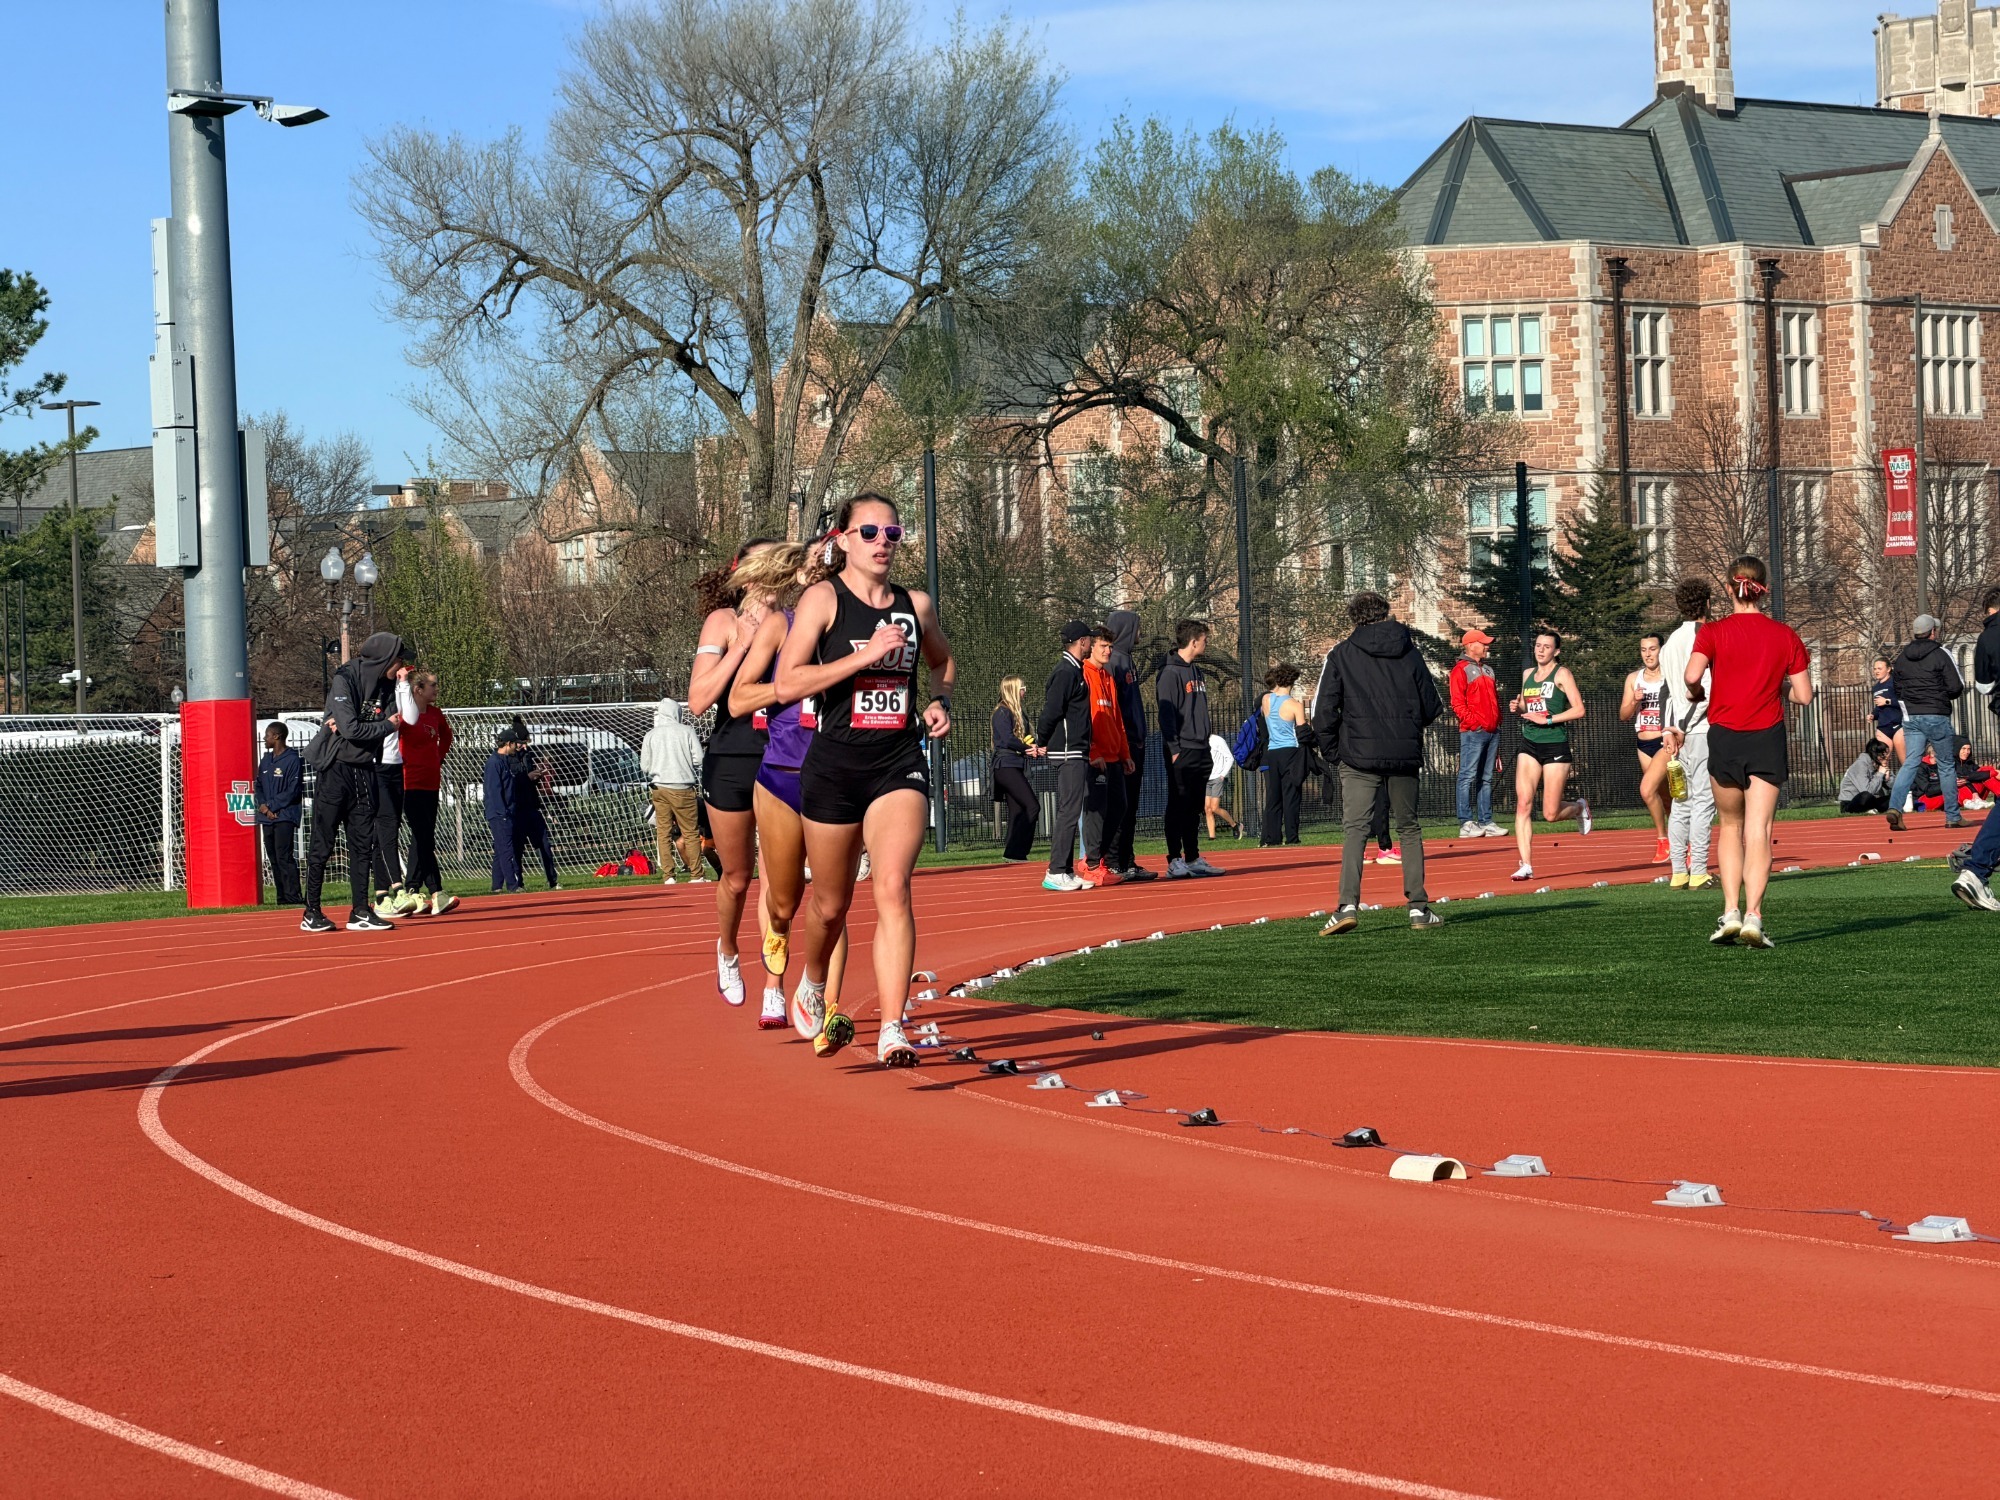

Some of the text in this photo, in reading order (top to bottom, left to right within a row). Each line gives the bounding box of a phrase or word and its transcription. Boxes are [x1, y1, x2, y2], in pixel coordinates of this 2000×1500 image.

[1890, 461, 1910, 470] WASH
[861, 691, 900, 712] 596
[1641, 702, 1660, 710] STAT
[1530, 702, 1543, 712] 423
[1643, 716, 1660, 725] 525
[226, 794, 256, 811] WA
